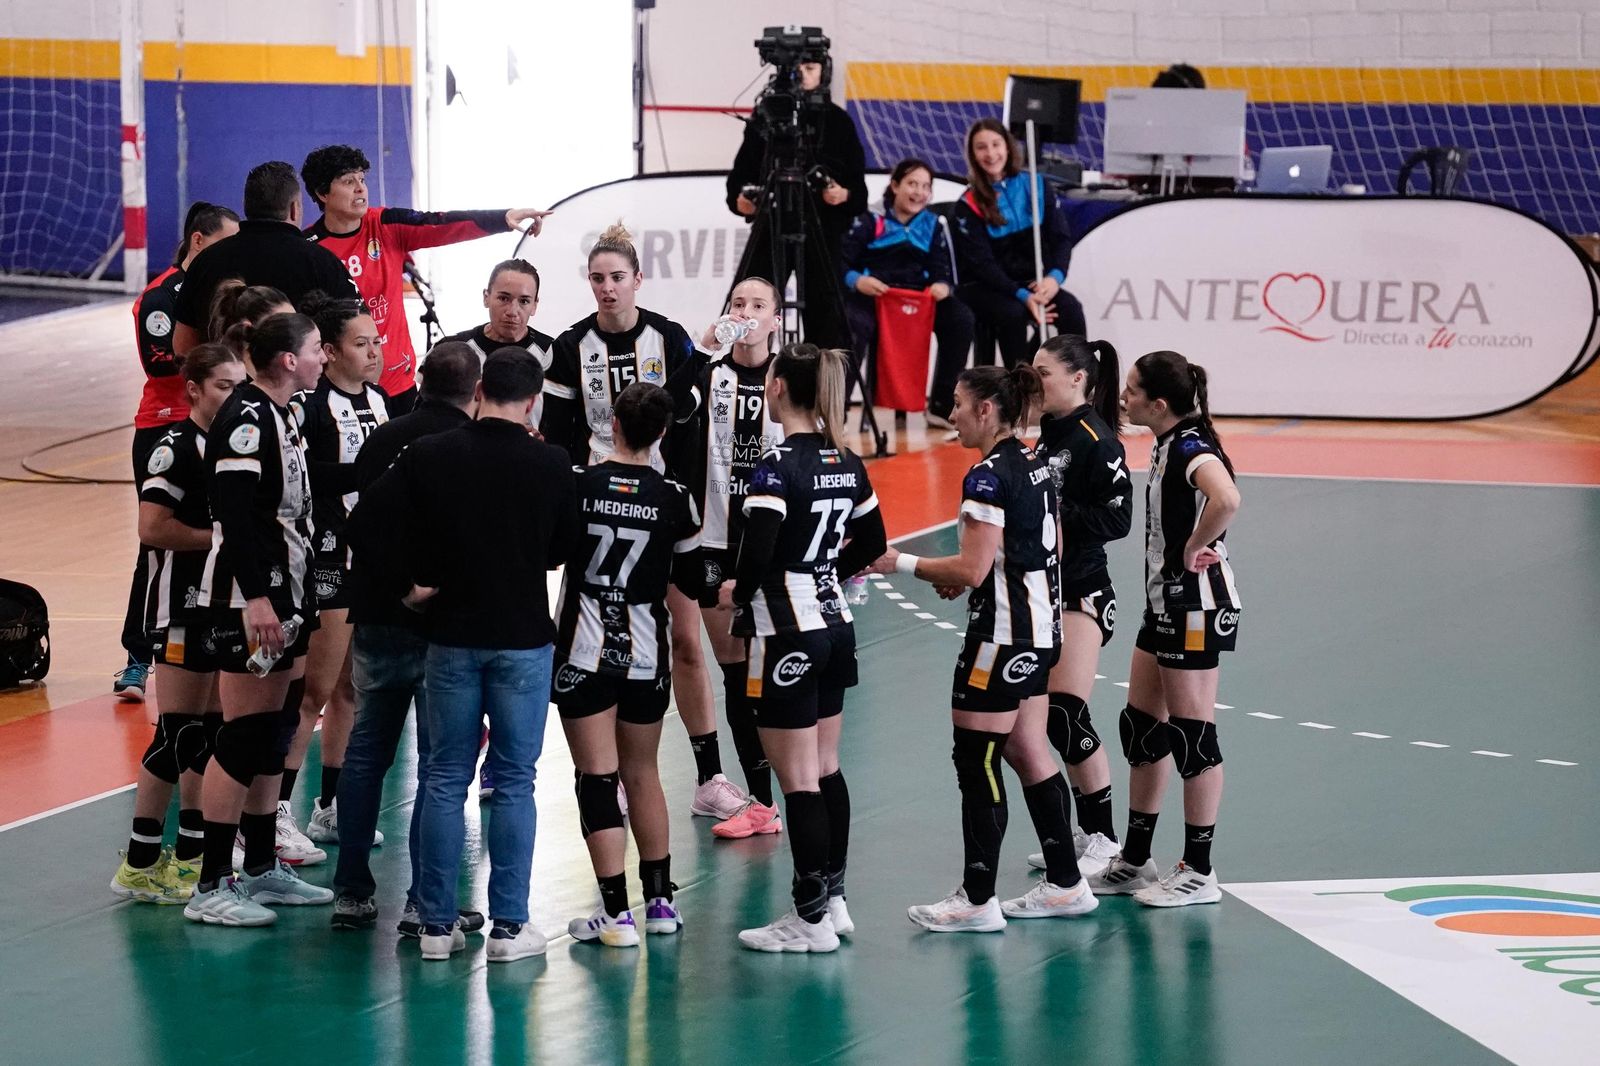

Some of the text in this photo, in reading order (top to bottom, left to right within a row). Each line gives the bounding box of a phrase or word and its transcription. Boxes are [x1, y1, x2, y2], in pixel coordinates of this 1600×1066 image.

[342, 255, 363, 277] 8
[1101, 273, 1491, 340] ANTEQUERA
[1343, 328, 1408, 345] Directa
[1415, 334, 1425, 345] a
[1457, 332, 1533, 348] corazón
[738, 395, 763, 420] 19
[710, 447, 761, 461] COMP
[593, 499, 659, 521] MEDEIROS
[803, 498, 853, 561] 73
[584, 523, 651, 588] 27
